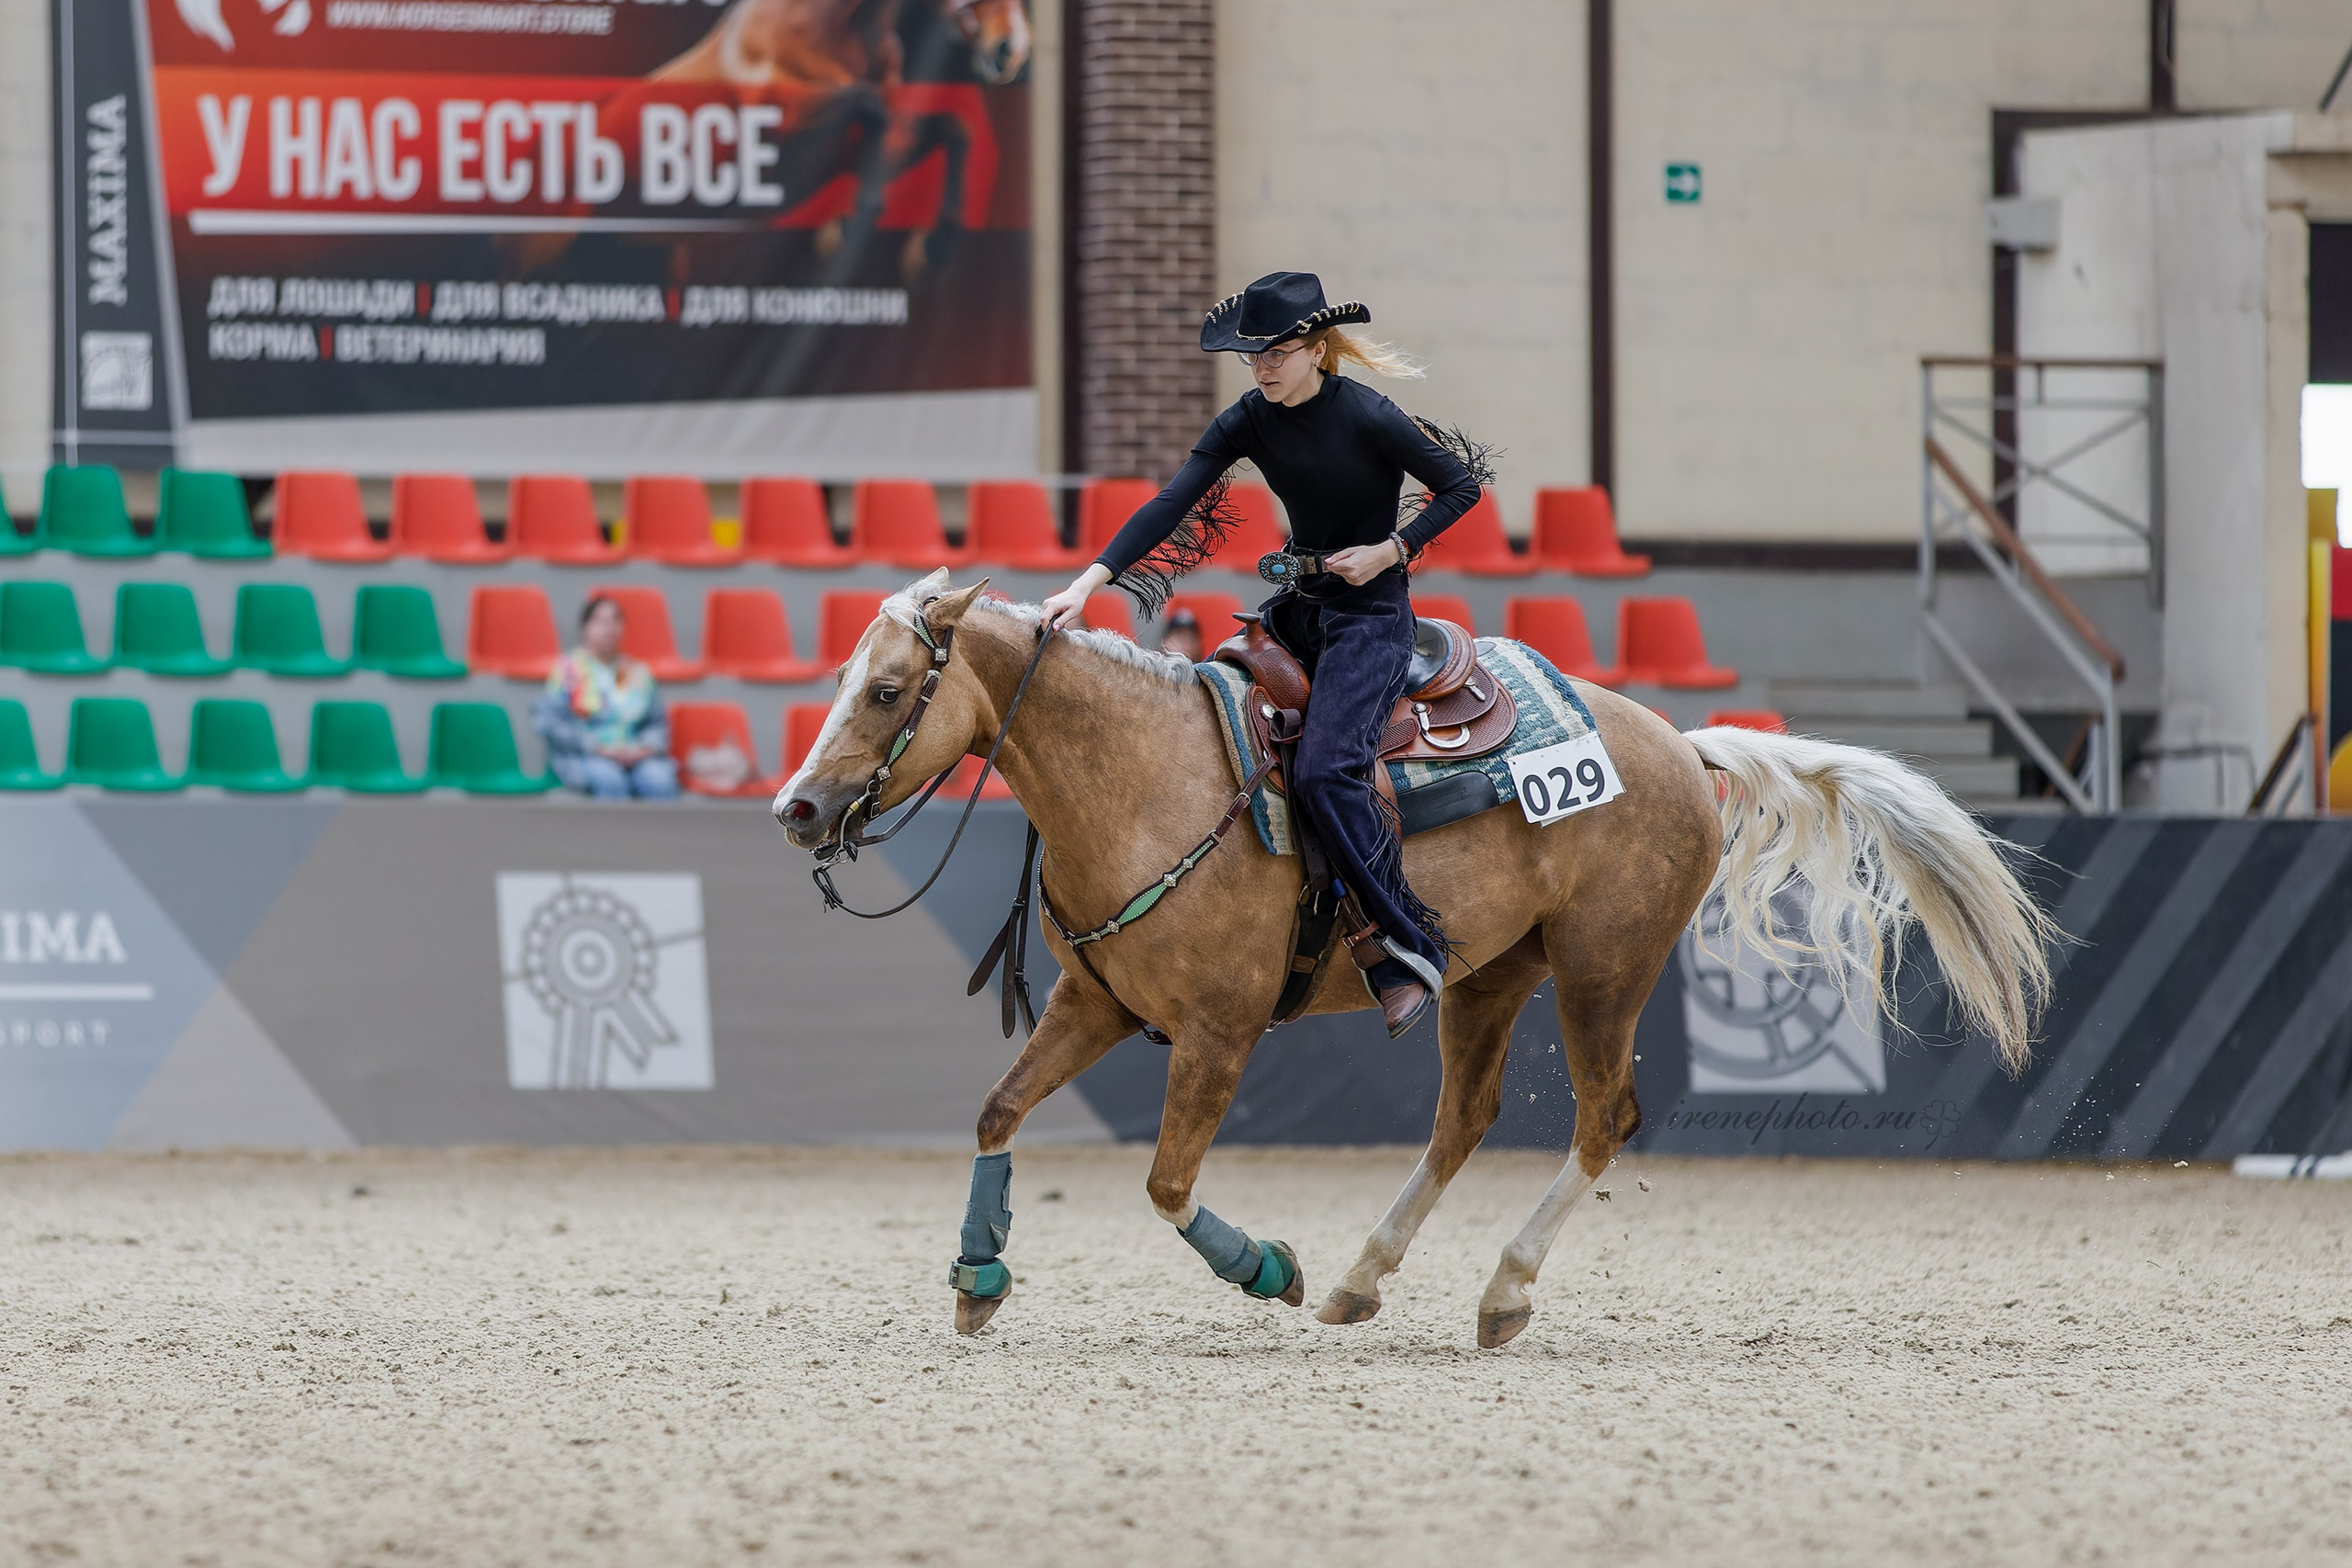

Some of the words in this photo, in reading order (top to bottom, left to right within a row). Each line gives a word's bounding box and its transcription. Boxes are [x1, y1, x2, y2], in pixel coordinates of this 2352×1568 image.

[196, 93, 253, 197] У
[268, 95, 423, 201] НАС
[437, 98, 626, 204] ЕСТЬ
[640, 103, 785, 207] ВСЕ
[86, 94, 128, 308] MAXIMA
[207, 276, 276, 319] ДЛЯ
[277, 277, 414, 321] ЛОШАДИ
[432, 280, 501, 323] ДЛЯ
[503, 282, 665, 326] ВСАДНИКА
[681, 284, 750, 328] ДЛЯ
[751, 287, 909, 327] КОНЮШНИ
[208, 321, 319, 361] КОРМА
[334, 325, 547, 366] ВЕТЕРИНАРИЯ
[1522, 758, 1606, 817] 029
